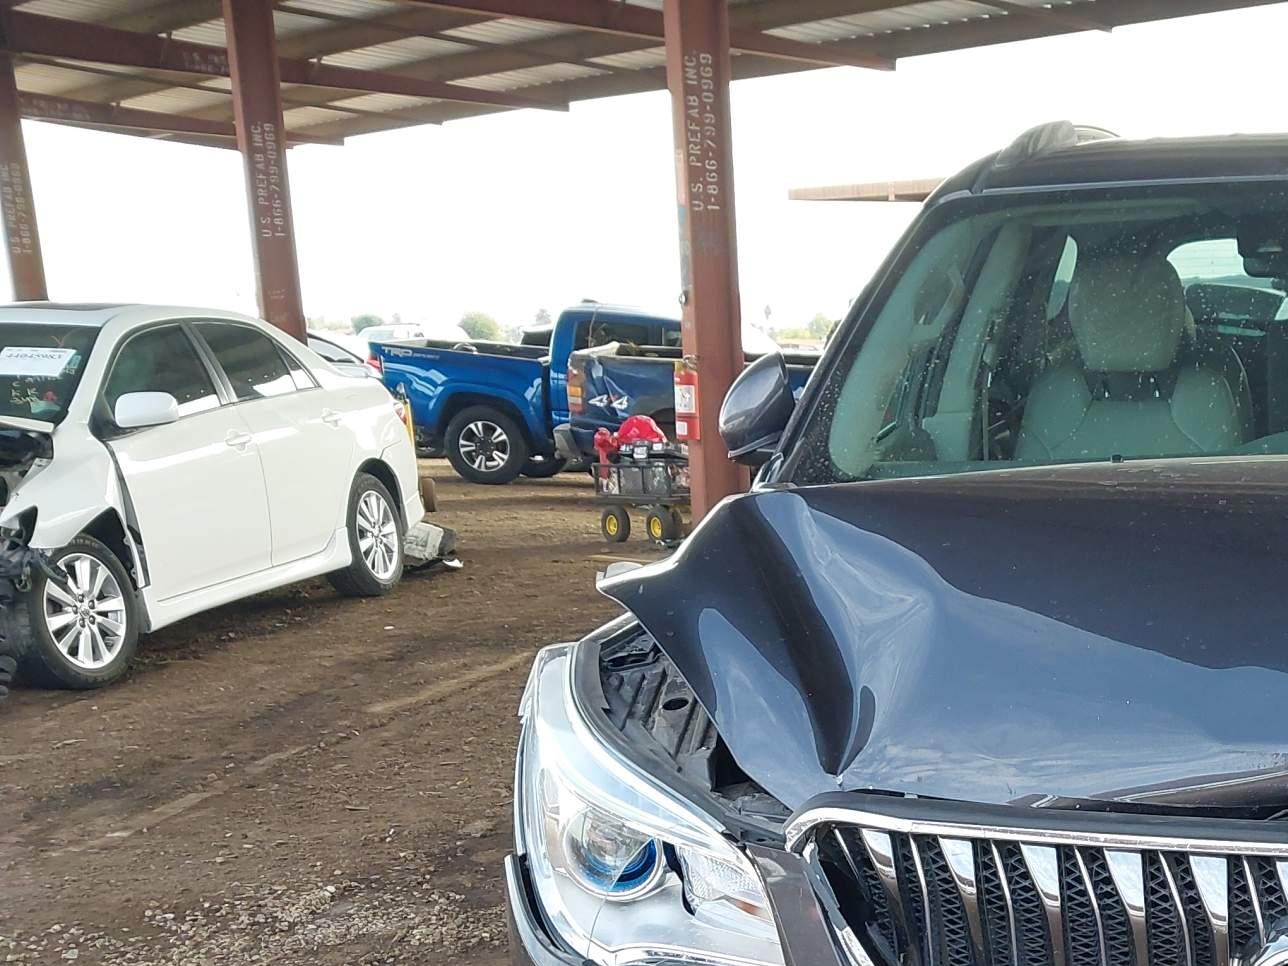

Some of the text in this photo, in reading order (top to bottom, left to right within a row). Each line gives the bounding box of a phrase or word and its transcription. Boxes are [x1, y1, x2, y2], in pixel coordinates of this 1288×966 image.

[686, 94, 702, 167] PREFAB
[699, 52, 720, 210] 1-866-799-0969
[253, 153, 270, 206] PREFAB
[381, 345, 413, 358] TRD
